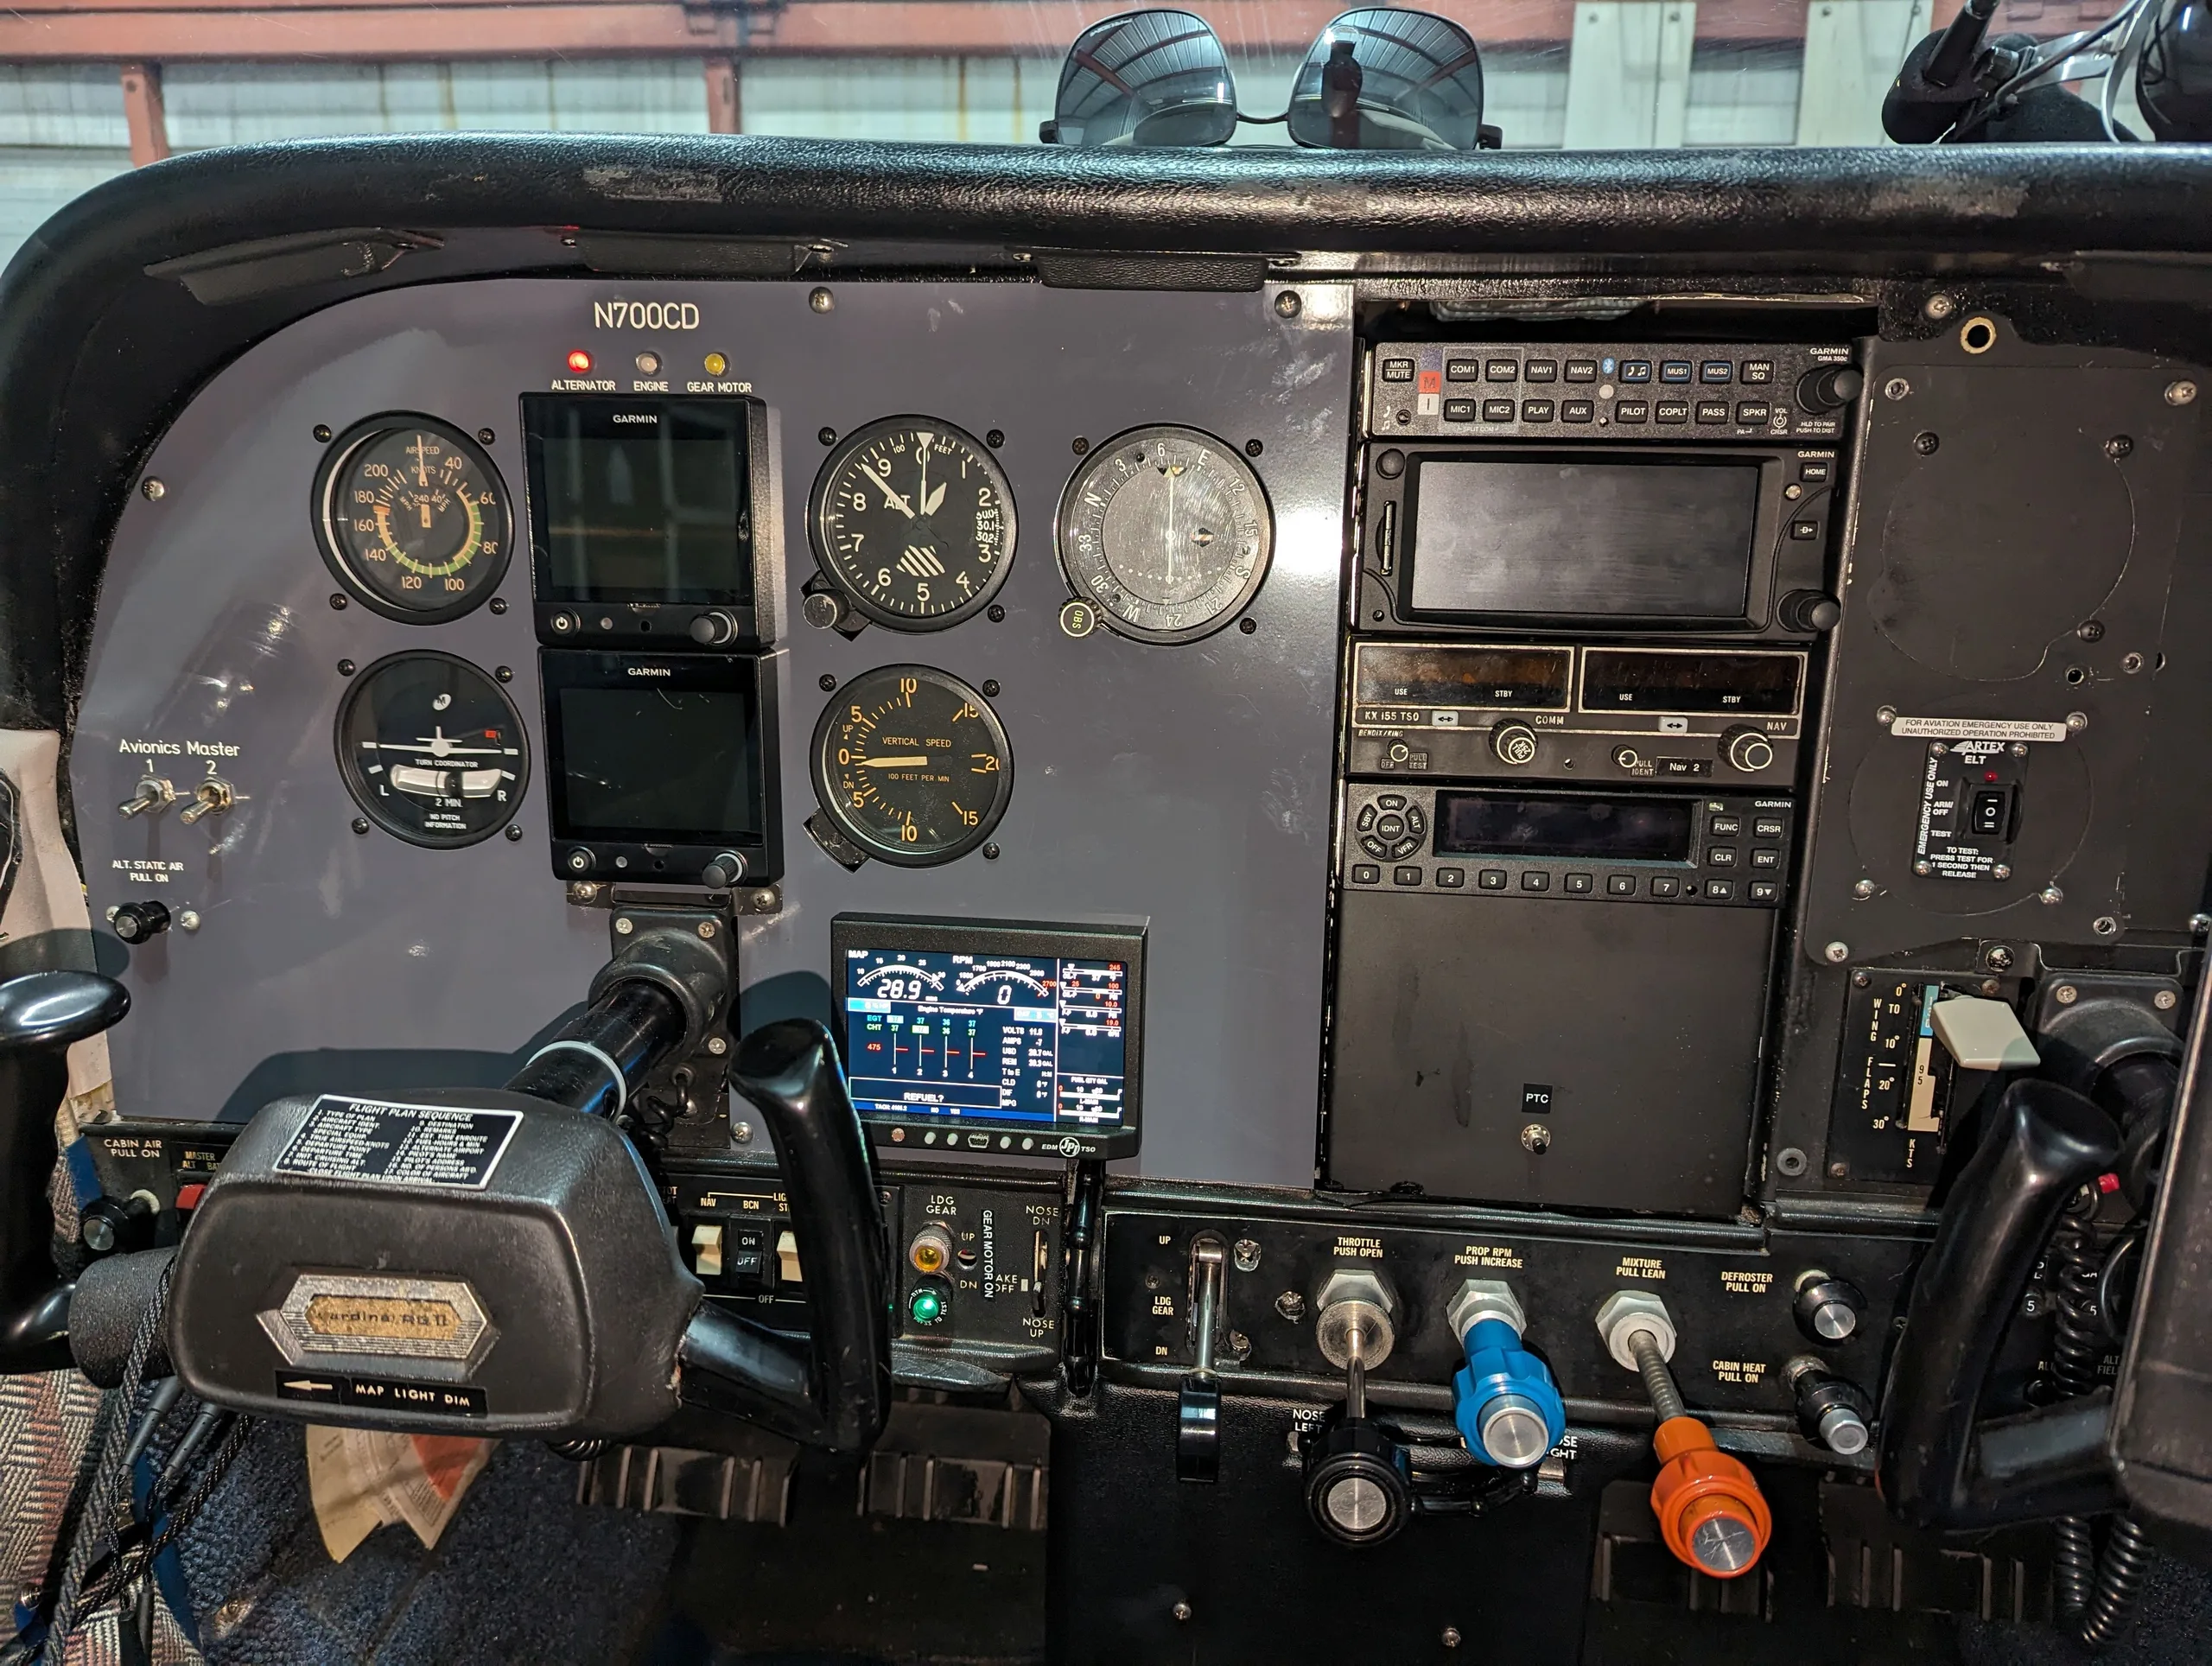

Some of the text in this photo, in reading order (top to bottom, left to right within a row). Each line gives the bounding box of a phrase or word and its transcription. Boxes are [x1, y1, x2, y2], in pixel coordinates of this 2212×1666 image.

[594, 302, 700, 330] N700CD
[551, 380, 615, 391] ALTERNATOR
[634, 381, 668, 391] ENGINE
[687, 382, 752, 393] GEAR MOTOR
[1659, 408, 1688, 416] COPLT
[613, 415, 657, 423] GARMIN
[934, 444, 952, 455] FEET
[365, 464, 388, 477] 200
[355, 491, 374, 503] 180
[853, 493, 866, 511] 8
[1084, 492, 1101, 506] N
[354, 520, 374, 531] 160
[1078, 534, 1091, 551] 33
[365, 550, 386, 561] 140
[402, 577, 422, 588] 120
[445, 578, 464, 590] 100
[917, 583, 930, 601] 5
[1072, 611, 1084, 628] OBS
[628, 668, 671, 677] GARMIN
[1382, 712, 1397, 721] 155
[1401, 713, 1419, 722] TSO
[1535, 715, 1564, 724] COMM
[1767, 722, 1787, 731] NAV
[1357, 728, 1404, 737] BENDIX/KING
[882, 737, 918, 746] VERTICAL
[119, 739, 240, 756] Avionics Master
[1967, 741, 2005, 754] ARTEX
[1965, 755, 1986, 764] ELT
[1917, 757, 1937, 855] EMERGENCY USE ONLY
[1362, 812, 1372, 827] SBY
[1412, 816, 1421, 829] ALT
[1367, 841, 1382, 853] OFF
[1398, 843, 1413, 855] VFR
[135, 862, 166, 870] STATIC
[169, 862, 183, 871] AIR
[130, 873, 168, 882] PULL ON
[877, 979, 921, 1000] 28.9
[1889, 1005, 1900, 1014] TO
[904, 1092, 944, 1103] REFUEL?
[1526, 1093, 1548, 1103] PTC
[349, 1103, 473, 1122] FLIGHT PLAN SEQUENCE
[104, 1139, 139, 1148] CABIN
[931, 1195, 954, 1205] LDG
[926, 1205, 957, 1215] GEAR
[1026, 1205, 1058, 1216] NOSE
[1033, 1217, 1050, 1225] DN
[1159, 1236, 1171, 1244] UP
[1338, 1237, 1381, 1249] THROTTLE
[983, 1211, 994, 1298] GEAR MOTOR ON
[1334, 1246, 1383, 1258] PUSH OPEN
[1466, 1246, 1512, 1257] PROP RPM
[1455, 1255, 1522, 1268] PUSH INCREASE
[1622, 1257, 1662, 1269] MIXTURE
[1616, 1266, 1666, 1279] PULL LEAN
[1721, 1271, 1773, 1282] DEFROSTER
[1726, 1282, 1766, 1293] PULL ON
[1155, 1296, 1172, 1307] LDG
[1152, 1306, 1173, 1316] GEAR
[1023, 1318, 1054, 1329] NOSE
[1155, 1346, 1167, 1355] DN
[1713, 1360, 1766, 1373] CABIN HEAT
[1719, 1371, 1758, 1383] PULL ON
[356, 1384, 470, 1407] MAP LIGHT DIM
